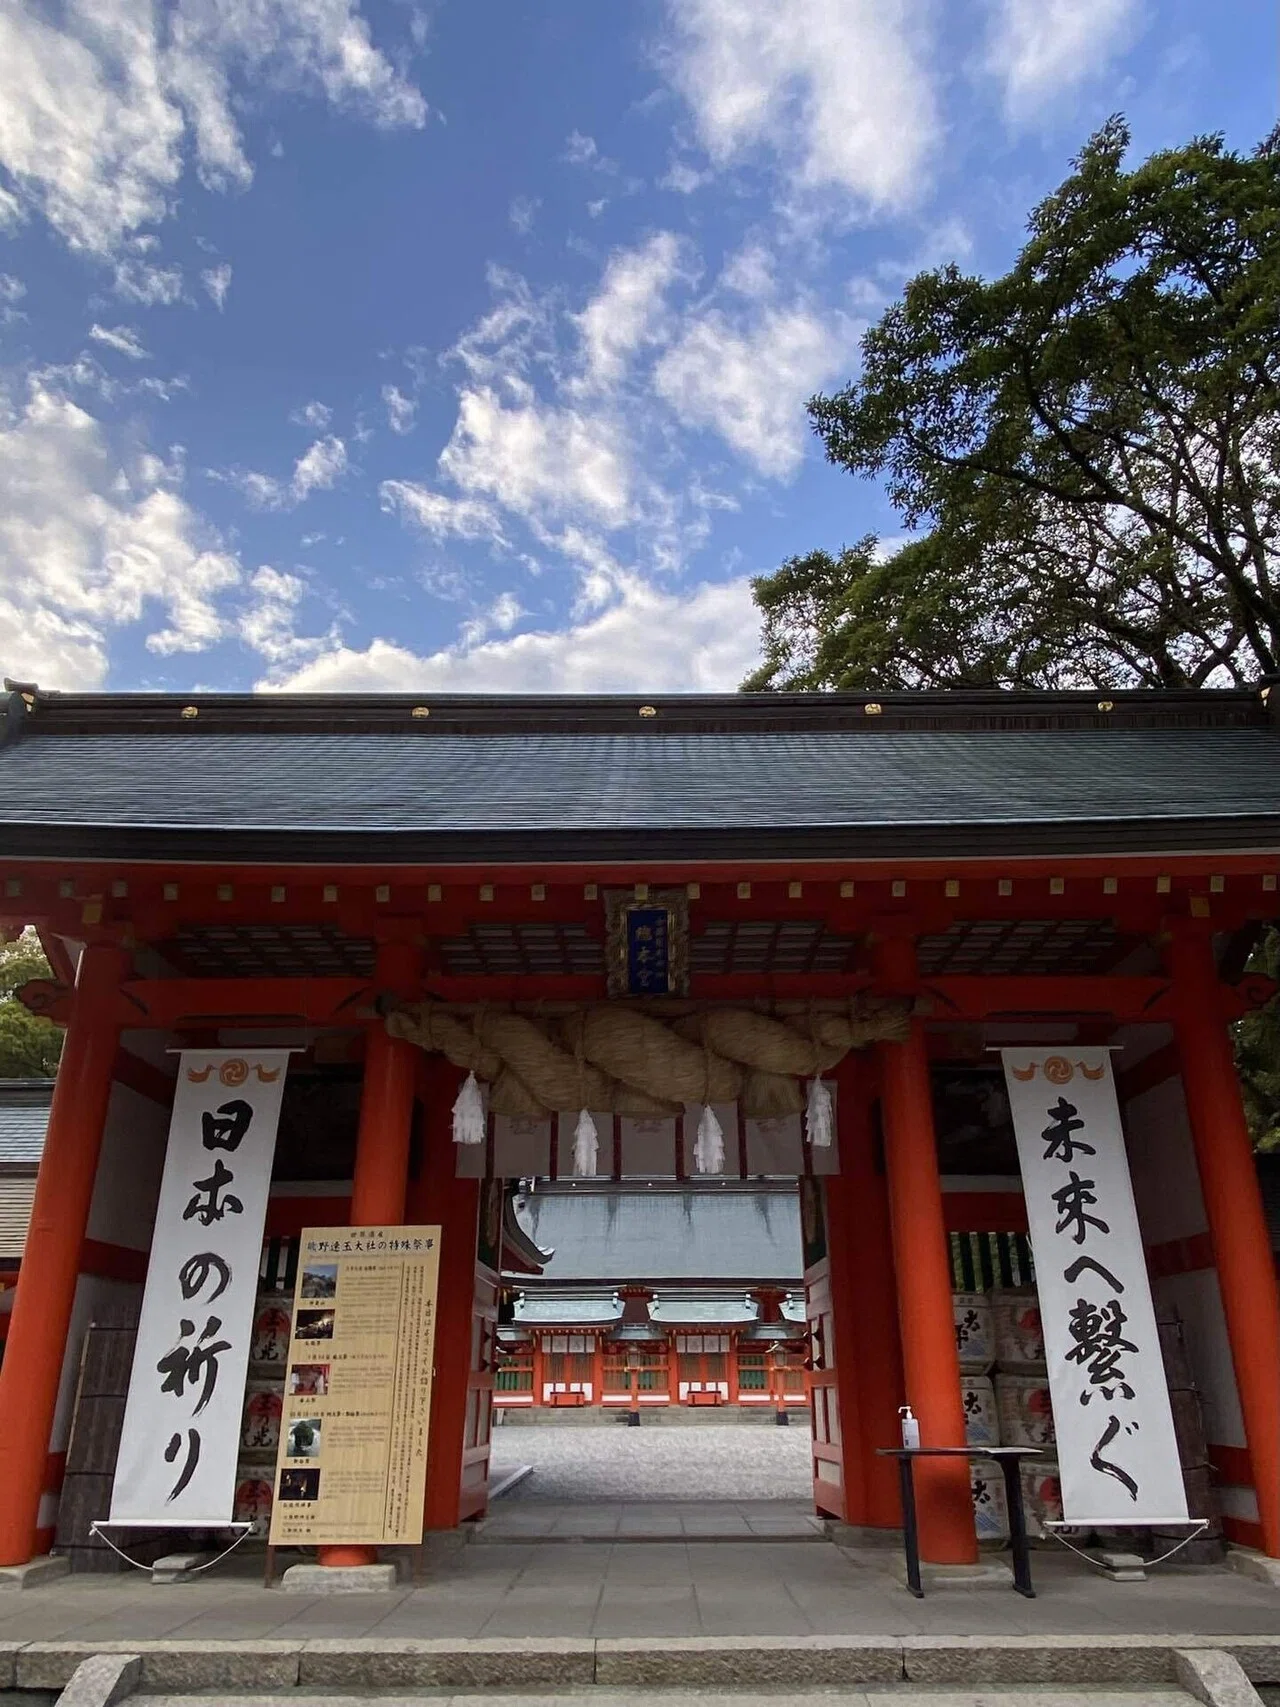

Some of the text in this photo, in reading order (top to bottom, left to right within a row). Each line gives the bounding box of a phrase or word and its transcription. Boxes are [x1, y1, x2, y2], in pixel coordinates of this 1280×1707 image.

[156, 1099, 253, 1506] 日本の祈り
[1041, 1096, 1140, 1501] 未来へ繋ぐ
